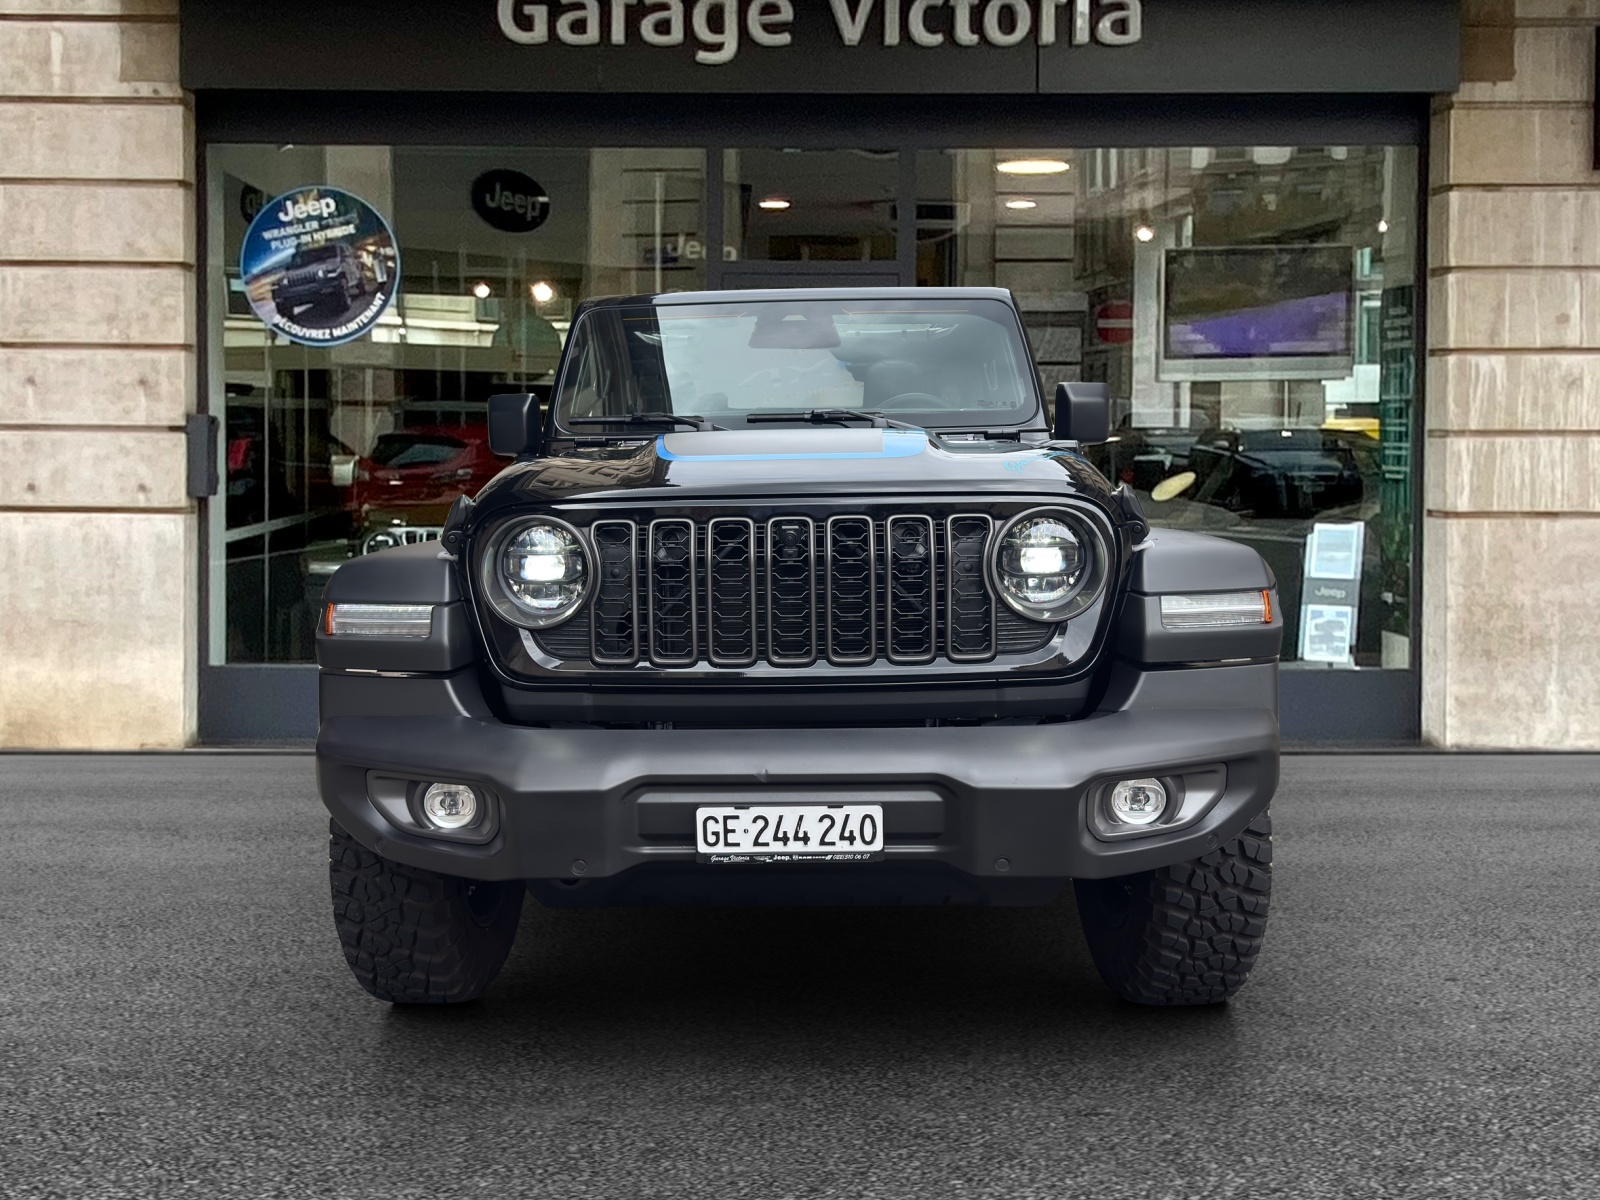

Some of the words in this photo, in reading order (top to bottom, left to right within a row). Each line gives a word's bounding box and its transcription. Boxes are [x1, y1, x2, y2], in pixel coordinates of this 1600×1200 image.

[497, 0, 794, 65] Garage
[828, 0, 1142, 46] Victoria
[278, 197, 336, 222] Jeep
[485, 181, 541, 221] Jeep
[262, 220, 320, 240] WRANGLER
[270, 233, 312, 250] PLUG-IN
[332, 291, 386, 338] MAINTENANT
[1315, 586, 1346, 599] Jeep
[818, 813, 878, 846] 240
